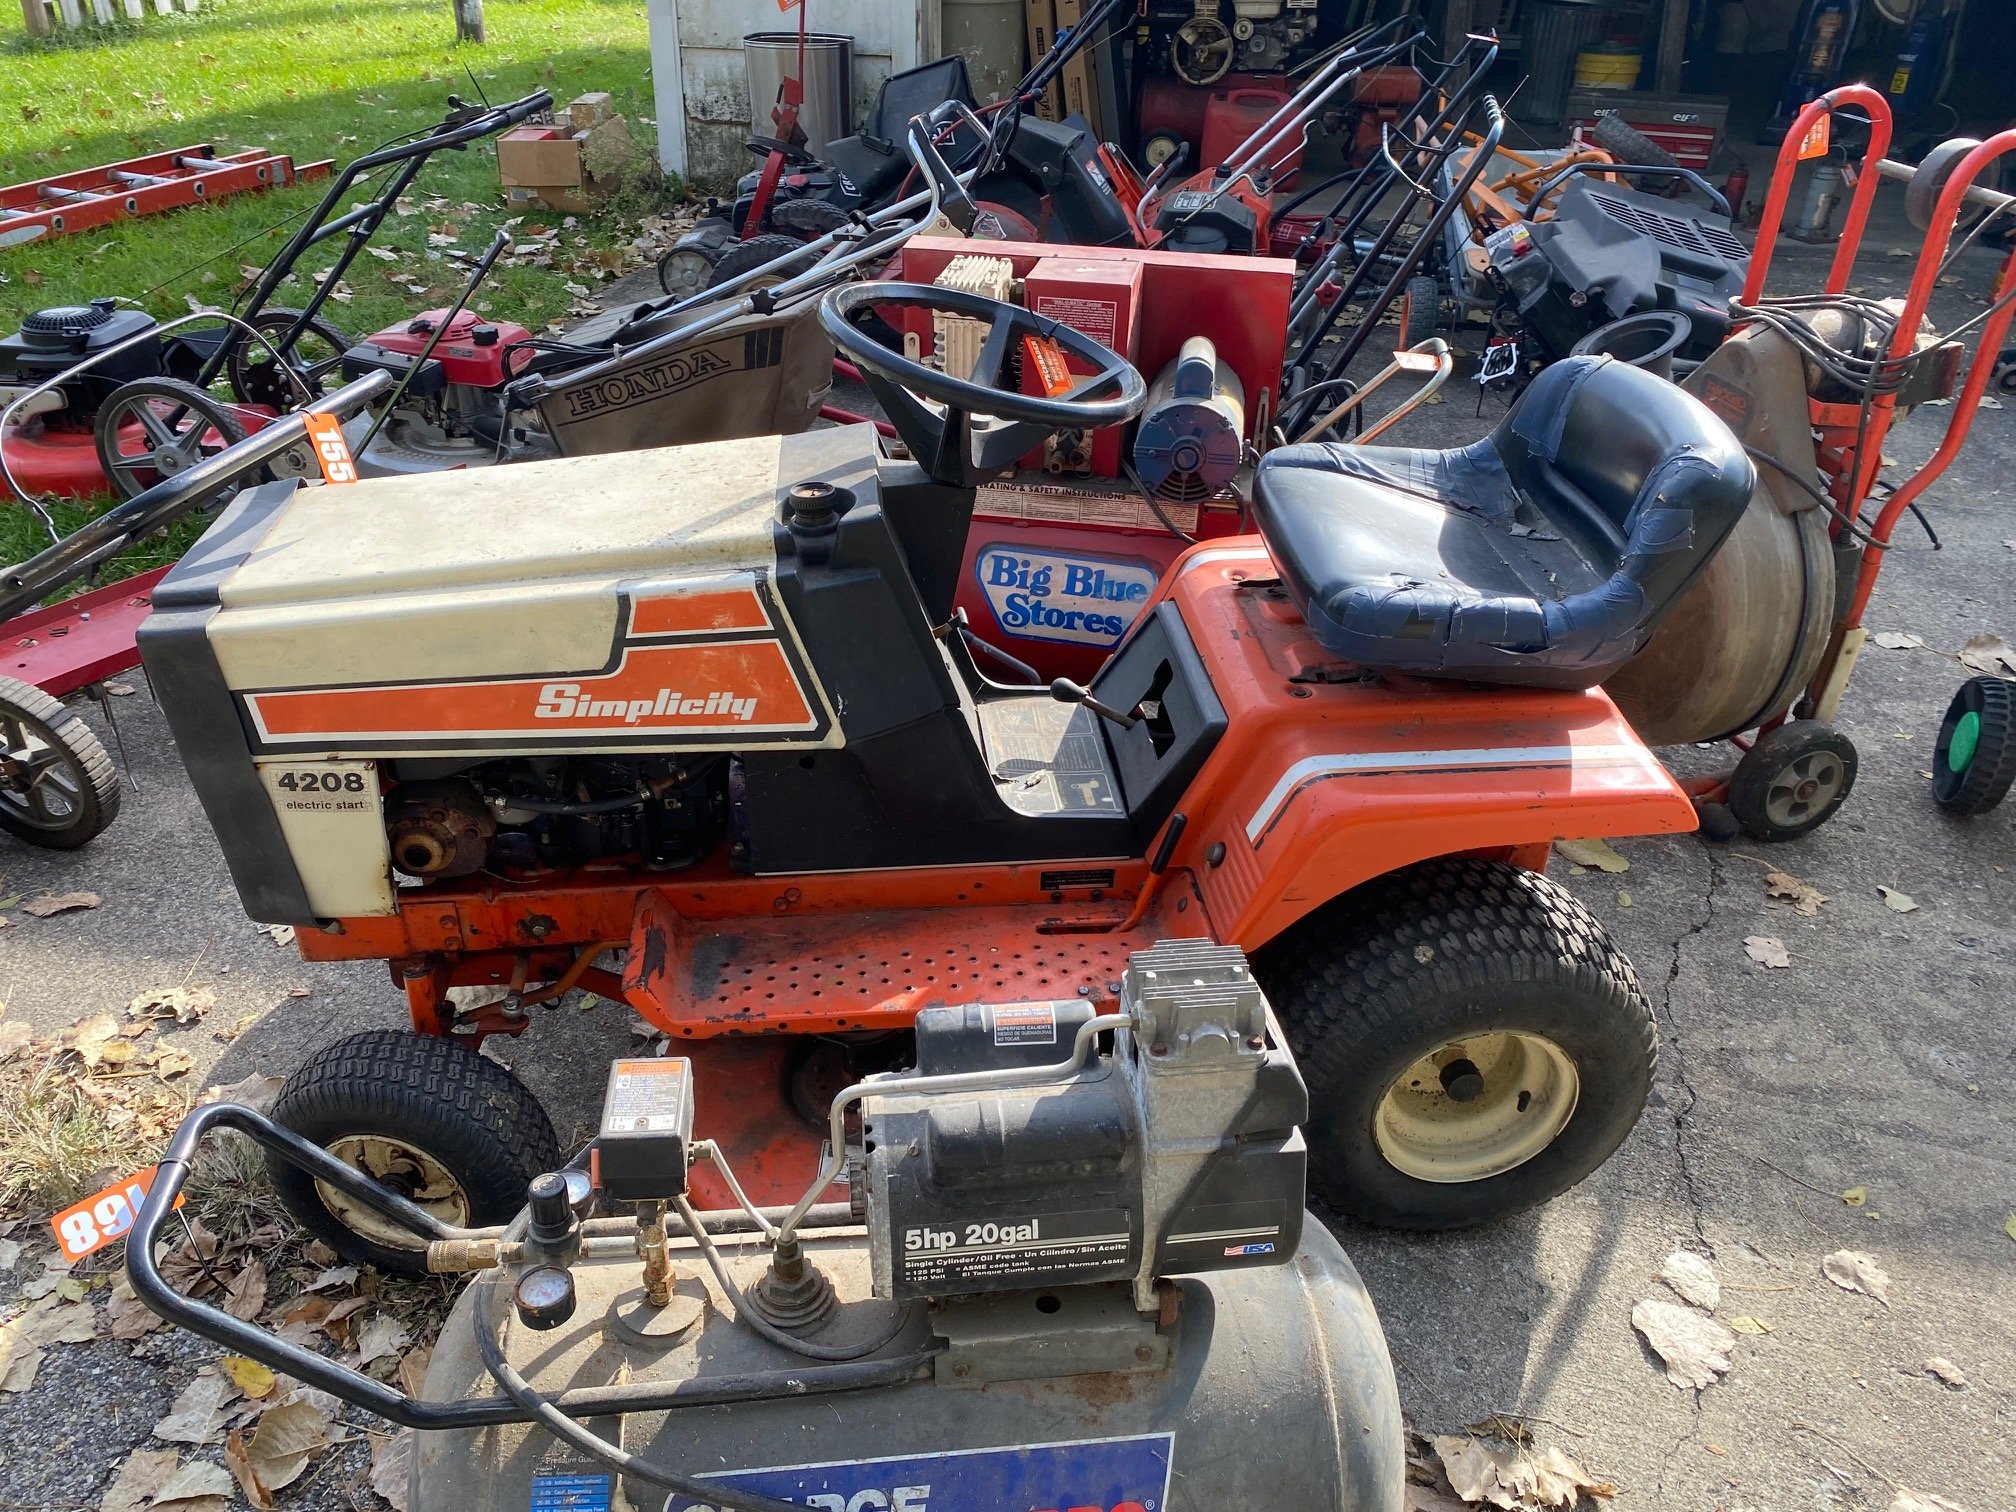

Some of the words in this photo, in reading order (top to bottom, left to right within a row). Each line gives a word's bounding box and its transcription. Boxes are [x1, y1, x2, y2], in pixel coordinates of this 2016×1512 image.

[1673, 113, 1691, 122] elf
[565, 349, 731, 416] HONDA
[315, 428, 355, 482] 155
[1028, 486, 1059, 494] SAFETY
[987, 554, 1053, 597] Big
[1061, 563, 1147, 602] Blue
[1001, 592, 1123, 636] Stores
[534, 684, 758, 723] Simplicity
[278, 772, 365, 792] 4208
[286, 800, 332, 809] electric
[336, 801, 364, 809] start
[904, 1227, 957, 1252] 5hp
[965, 1219, 1039, 1247] 20gal
[1243, 1243, 1274, 1254] USA
[905, 1259, 934, 1268] Single
[936, 1254, 993, 1266] Cylinder/Oil
[1039, 1246, 1096, 1256] Cilindro/Sin
[1098, 1243, 1127, 1251] Aceite
